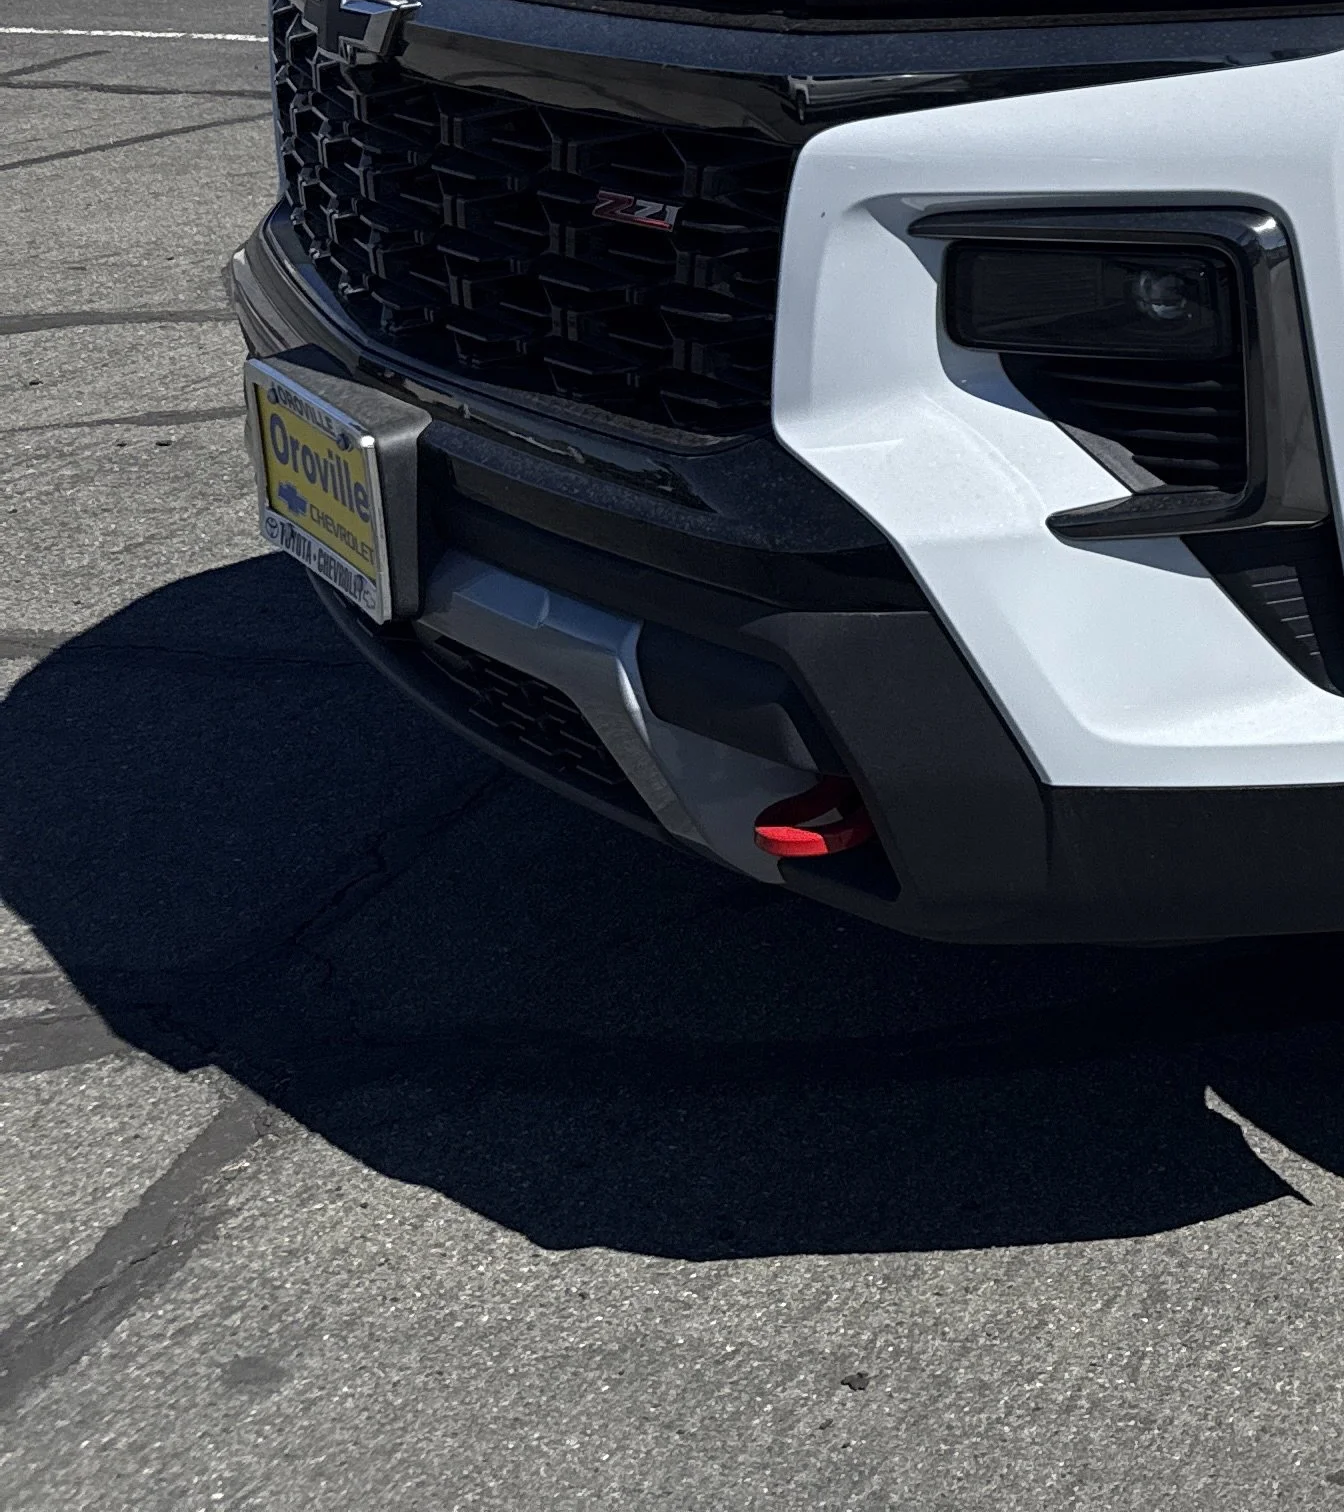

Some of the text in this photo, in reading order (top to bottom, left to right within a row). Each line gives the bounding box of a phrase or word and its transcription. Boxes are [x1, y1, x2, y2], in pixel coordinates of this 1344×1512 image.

[591, 189, 681, 232] Z71
[277, 386, 335, 436] OROVILLE
[269, 412, 371, 524] Oroville
[278, 520, 365, 604] TOYOTA CHEVROLET
[309, 502, 375, 566] CHEVROLET
